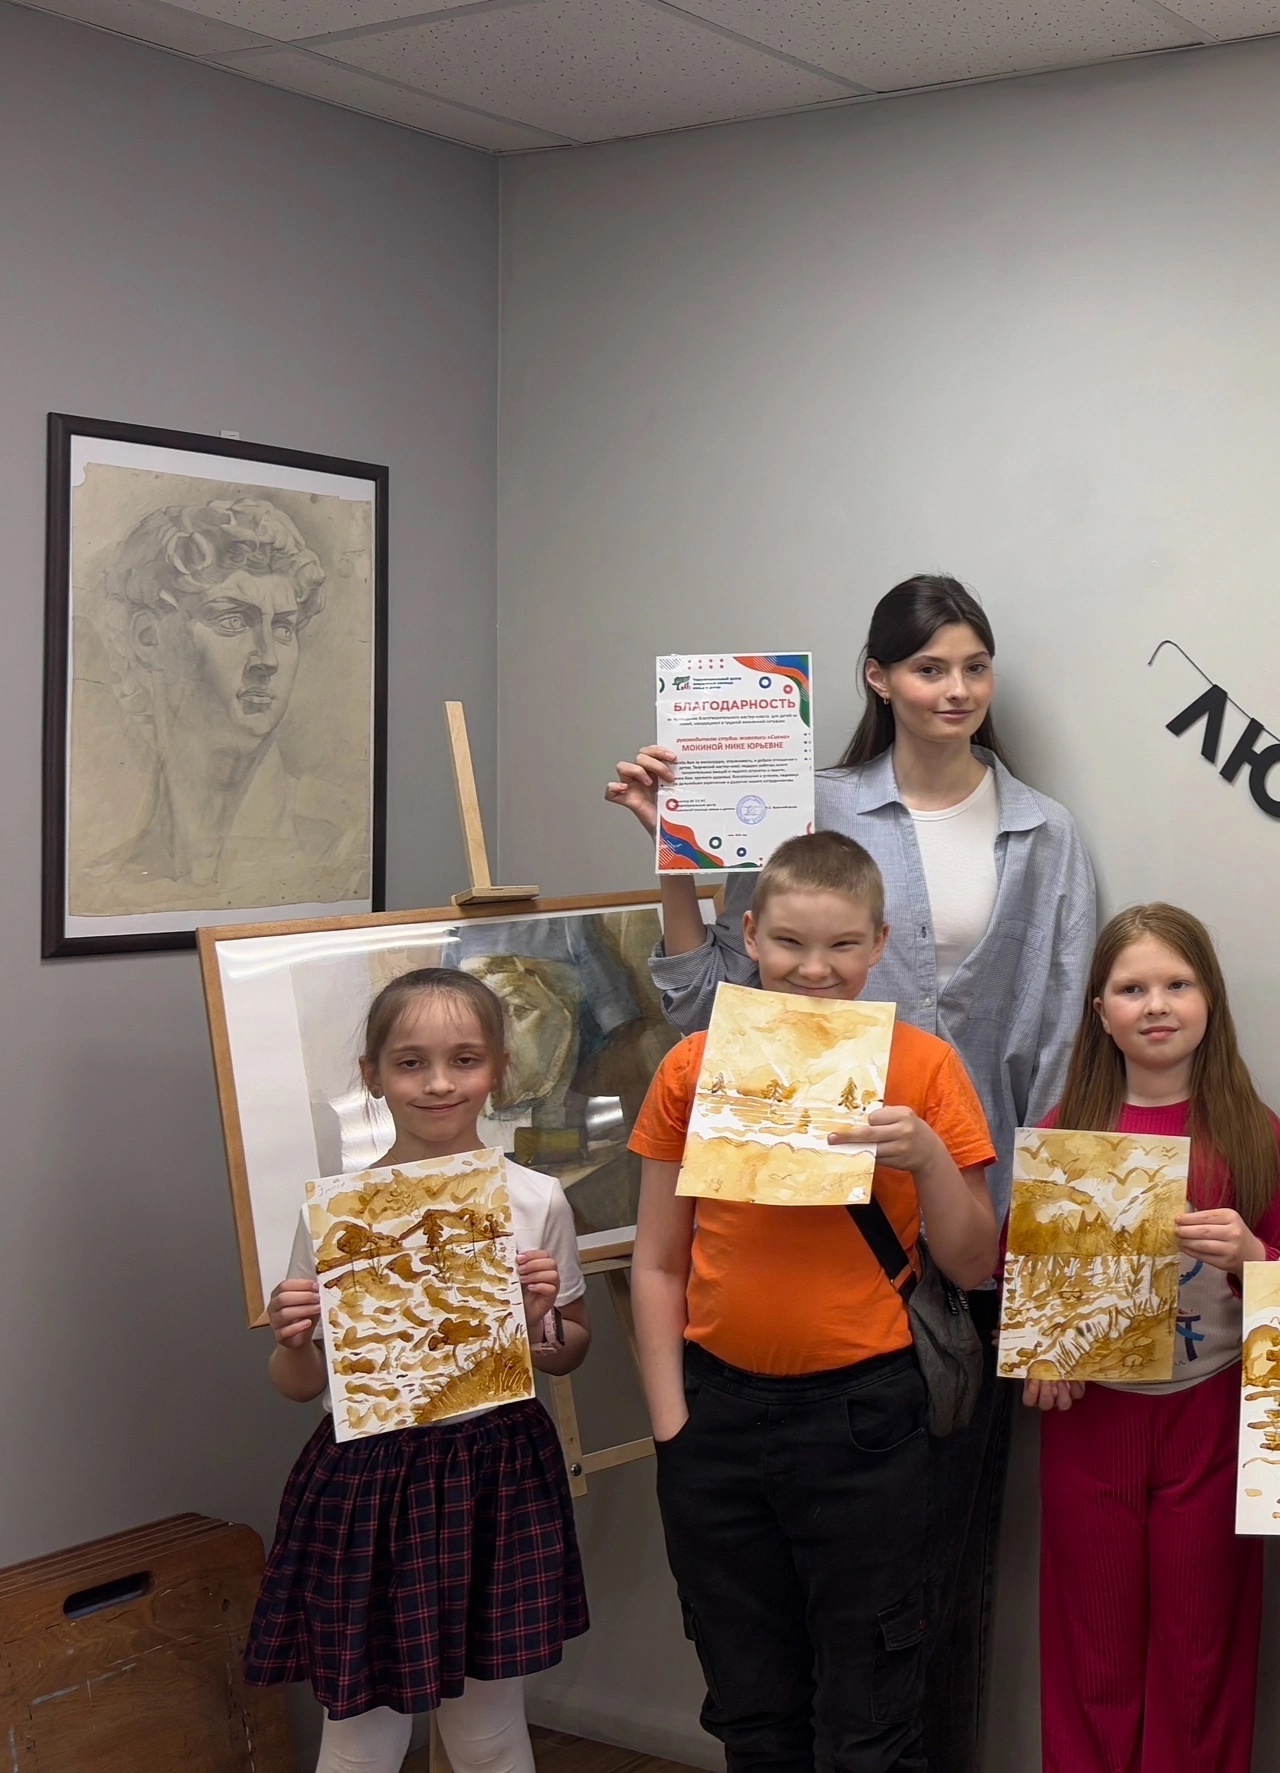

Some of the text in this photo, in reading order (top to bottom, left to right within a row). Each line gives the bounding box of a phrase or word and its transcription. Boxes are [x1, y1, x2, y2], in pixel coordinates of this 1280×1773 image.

[673, 698, 796, 712] БЛАГОДАРНОСТЬ
[724, 742, 746, 751] НИКЕ
[747, 741, 784, 750] ЮРЬЕВНЕ
